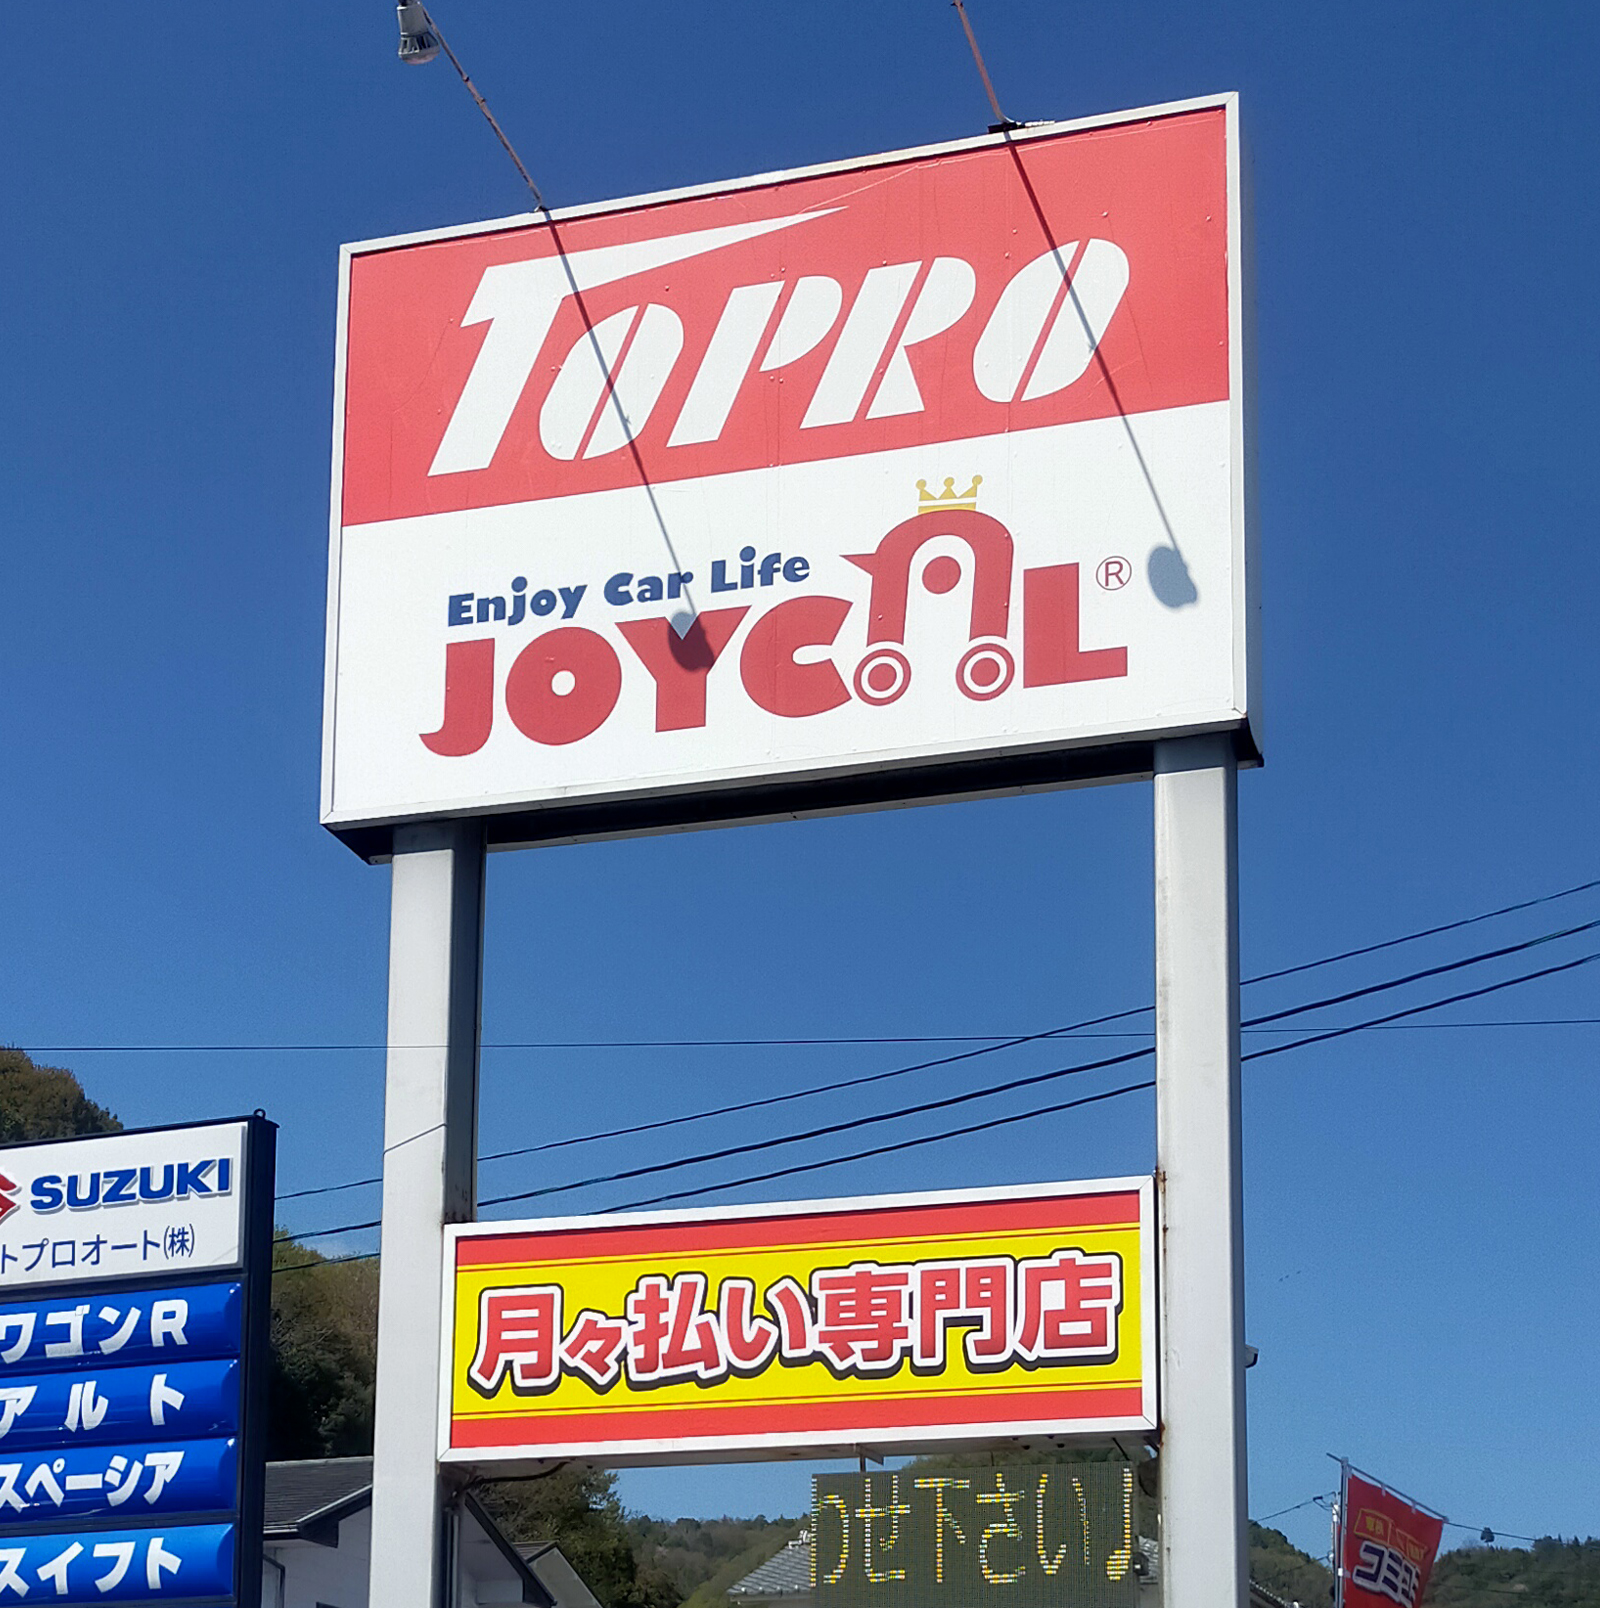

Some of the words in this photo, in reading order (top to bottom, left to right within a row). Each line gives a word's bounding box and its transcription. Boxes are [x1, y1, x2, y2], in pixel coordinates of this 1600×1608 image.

[427, 205, 1131, 477] TOPRO
[447, 576, 588, 627] Enjoy
[603, 570, 694, 607] Car
[710, 546, 811, 593] Life
[30, 1157, 233, 1212] SUZUKI
[0, 1298, 189, 1364] ワゴンR
[469, 1250, 1120, 1389] 月々払い専門店
[0, 1373, 186, 1439] アルト
[0, 1449, 185, 1513] スペーシア
[0, 1536, 183, 1598] スイフト
